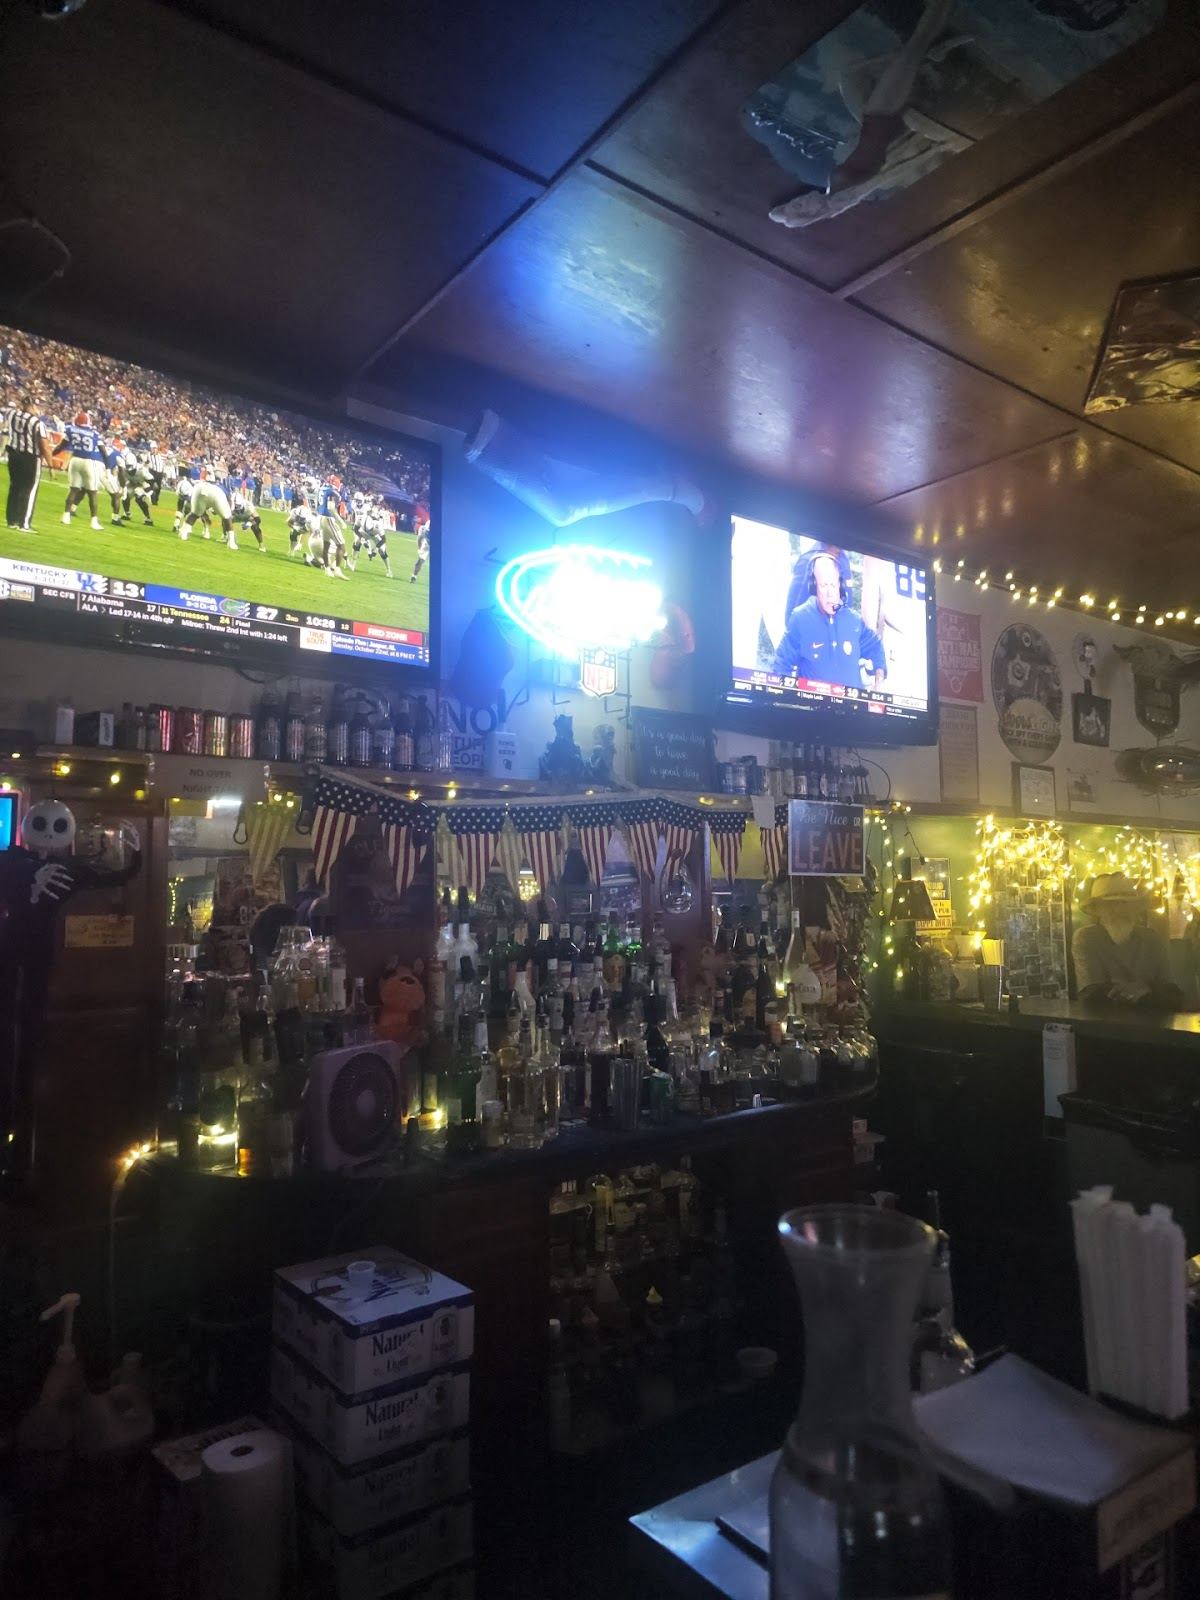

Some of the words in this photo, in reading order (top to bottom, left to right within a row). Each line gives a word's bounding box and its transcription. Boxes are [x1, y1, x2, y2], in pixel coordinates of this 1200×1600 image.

[13, 563, 68, 579] KENTUCKY
[42, 588, 58, 597] SEC
[59, 591, 75, 600] CFB
[113, 581, 140, 598] 13
[87, 596, 124, 608] Alabama
[146, 604, 156, 612] 17
[179, 592, 217, 605] FLORIDA
[169, 608, 209, 622] Tennessee
[219, 616, 231, 625] 24
[256, 606, 278, 621] 27
[81, 603, 98, 612] ALA
[108, 607, 123, 616] Led
[150, 614, 163, 622] 4th
[163, 616, 175, 625] qtr
[205, 622, 226, 632] Throw
[226, 626, 240, 634] 2nd
[249, 630, 263, 638] with
[263, 632, 277, 640] 1:24
[277, 634, 288, 642] left
[386, 630, 408, 641] ZONE
[585, 664, 614, 691] NFL
[188, 768, 204, 778] NO
[794, 806, 817, 824] Be
[818, 807, 849, 826] Nice
[794, 830, 861, 871] LEAVE
